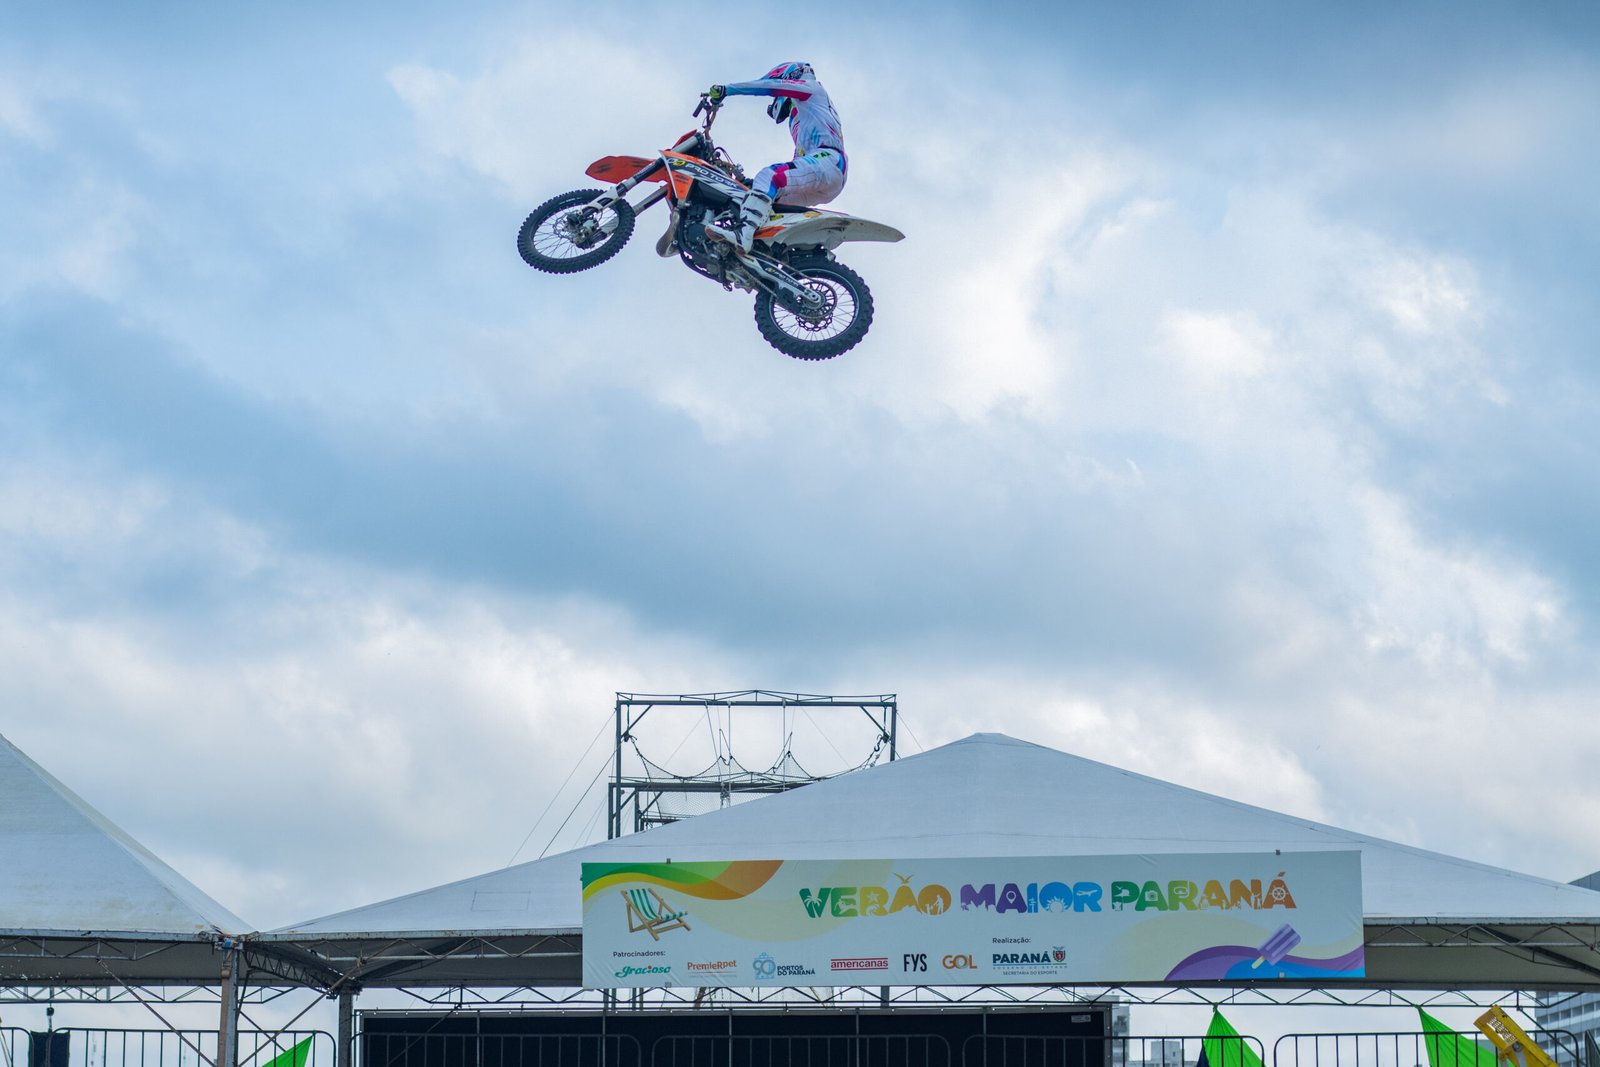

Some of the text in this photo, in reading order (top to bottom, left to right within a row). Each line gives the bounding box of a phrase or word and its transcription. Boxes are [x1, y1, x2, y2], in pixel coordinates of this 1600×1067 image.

[960, 881, 1103, 914] MAIOR
[1111, 871, 1297, 912] PARANÁ
[613, 950, 666, 958] Patrocinadores:
[992, 951, 1051, 963] PARANÁ
[831, 959, 888, 969] americanas
[903, 953, 928, 972] FYS
[942, 954, 977, 970] GOL
[788, 968, 816, 976] PARANÁ
